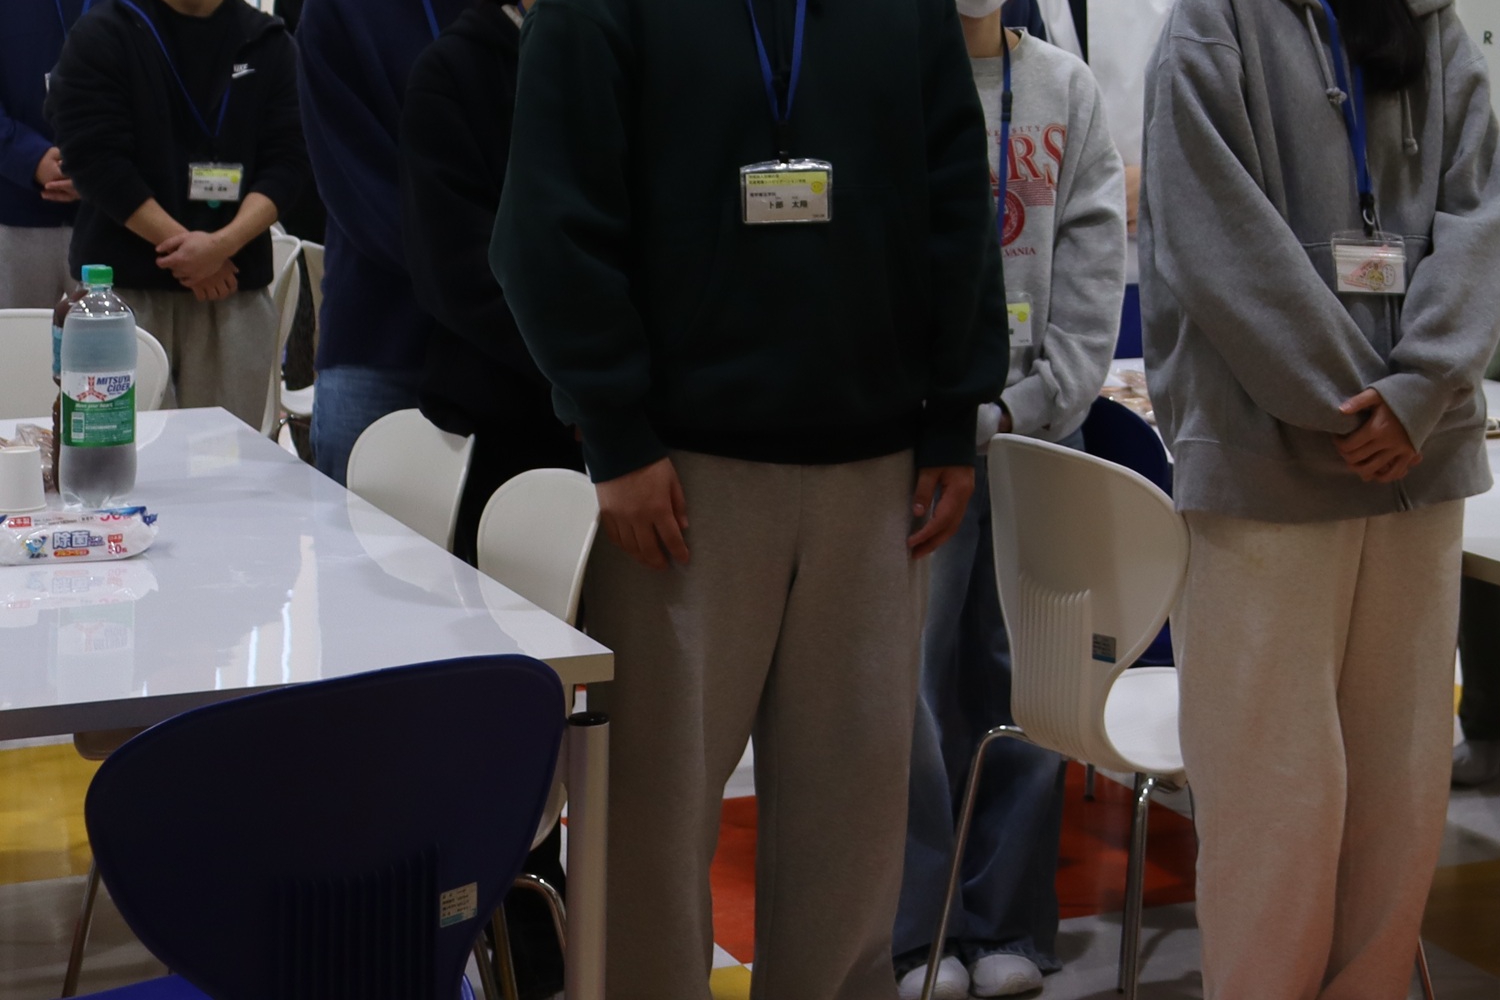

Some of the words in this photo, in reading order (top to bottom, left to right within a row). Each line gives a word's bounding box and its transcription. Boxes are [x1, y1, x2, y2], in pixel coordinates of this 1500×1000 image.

[96, 374, 131, 385] MITSUYA
[107, 383, 131, 393] CIDER
[53, 530, 90, 549] 除菌
